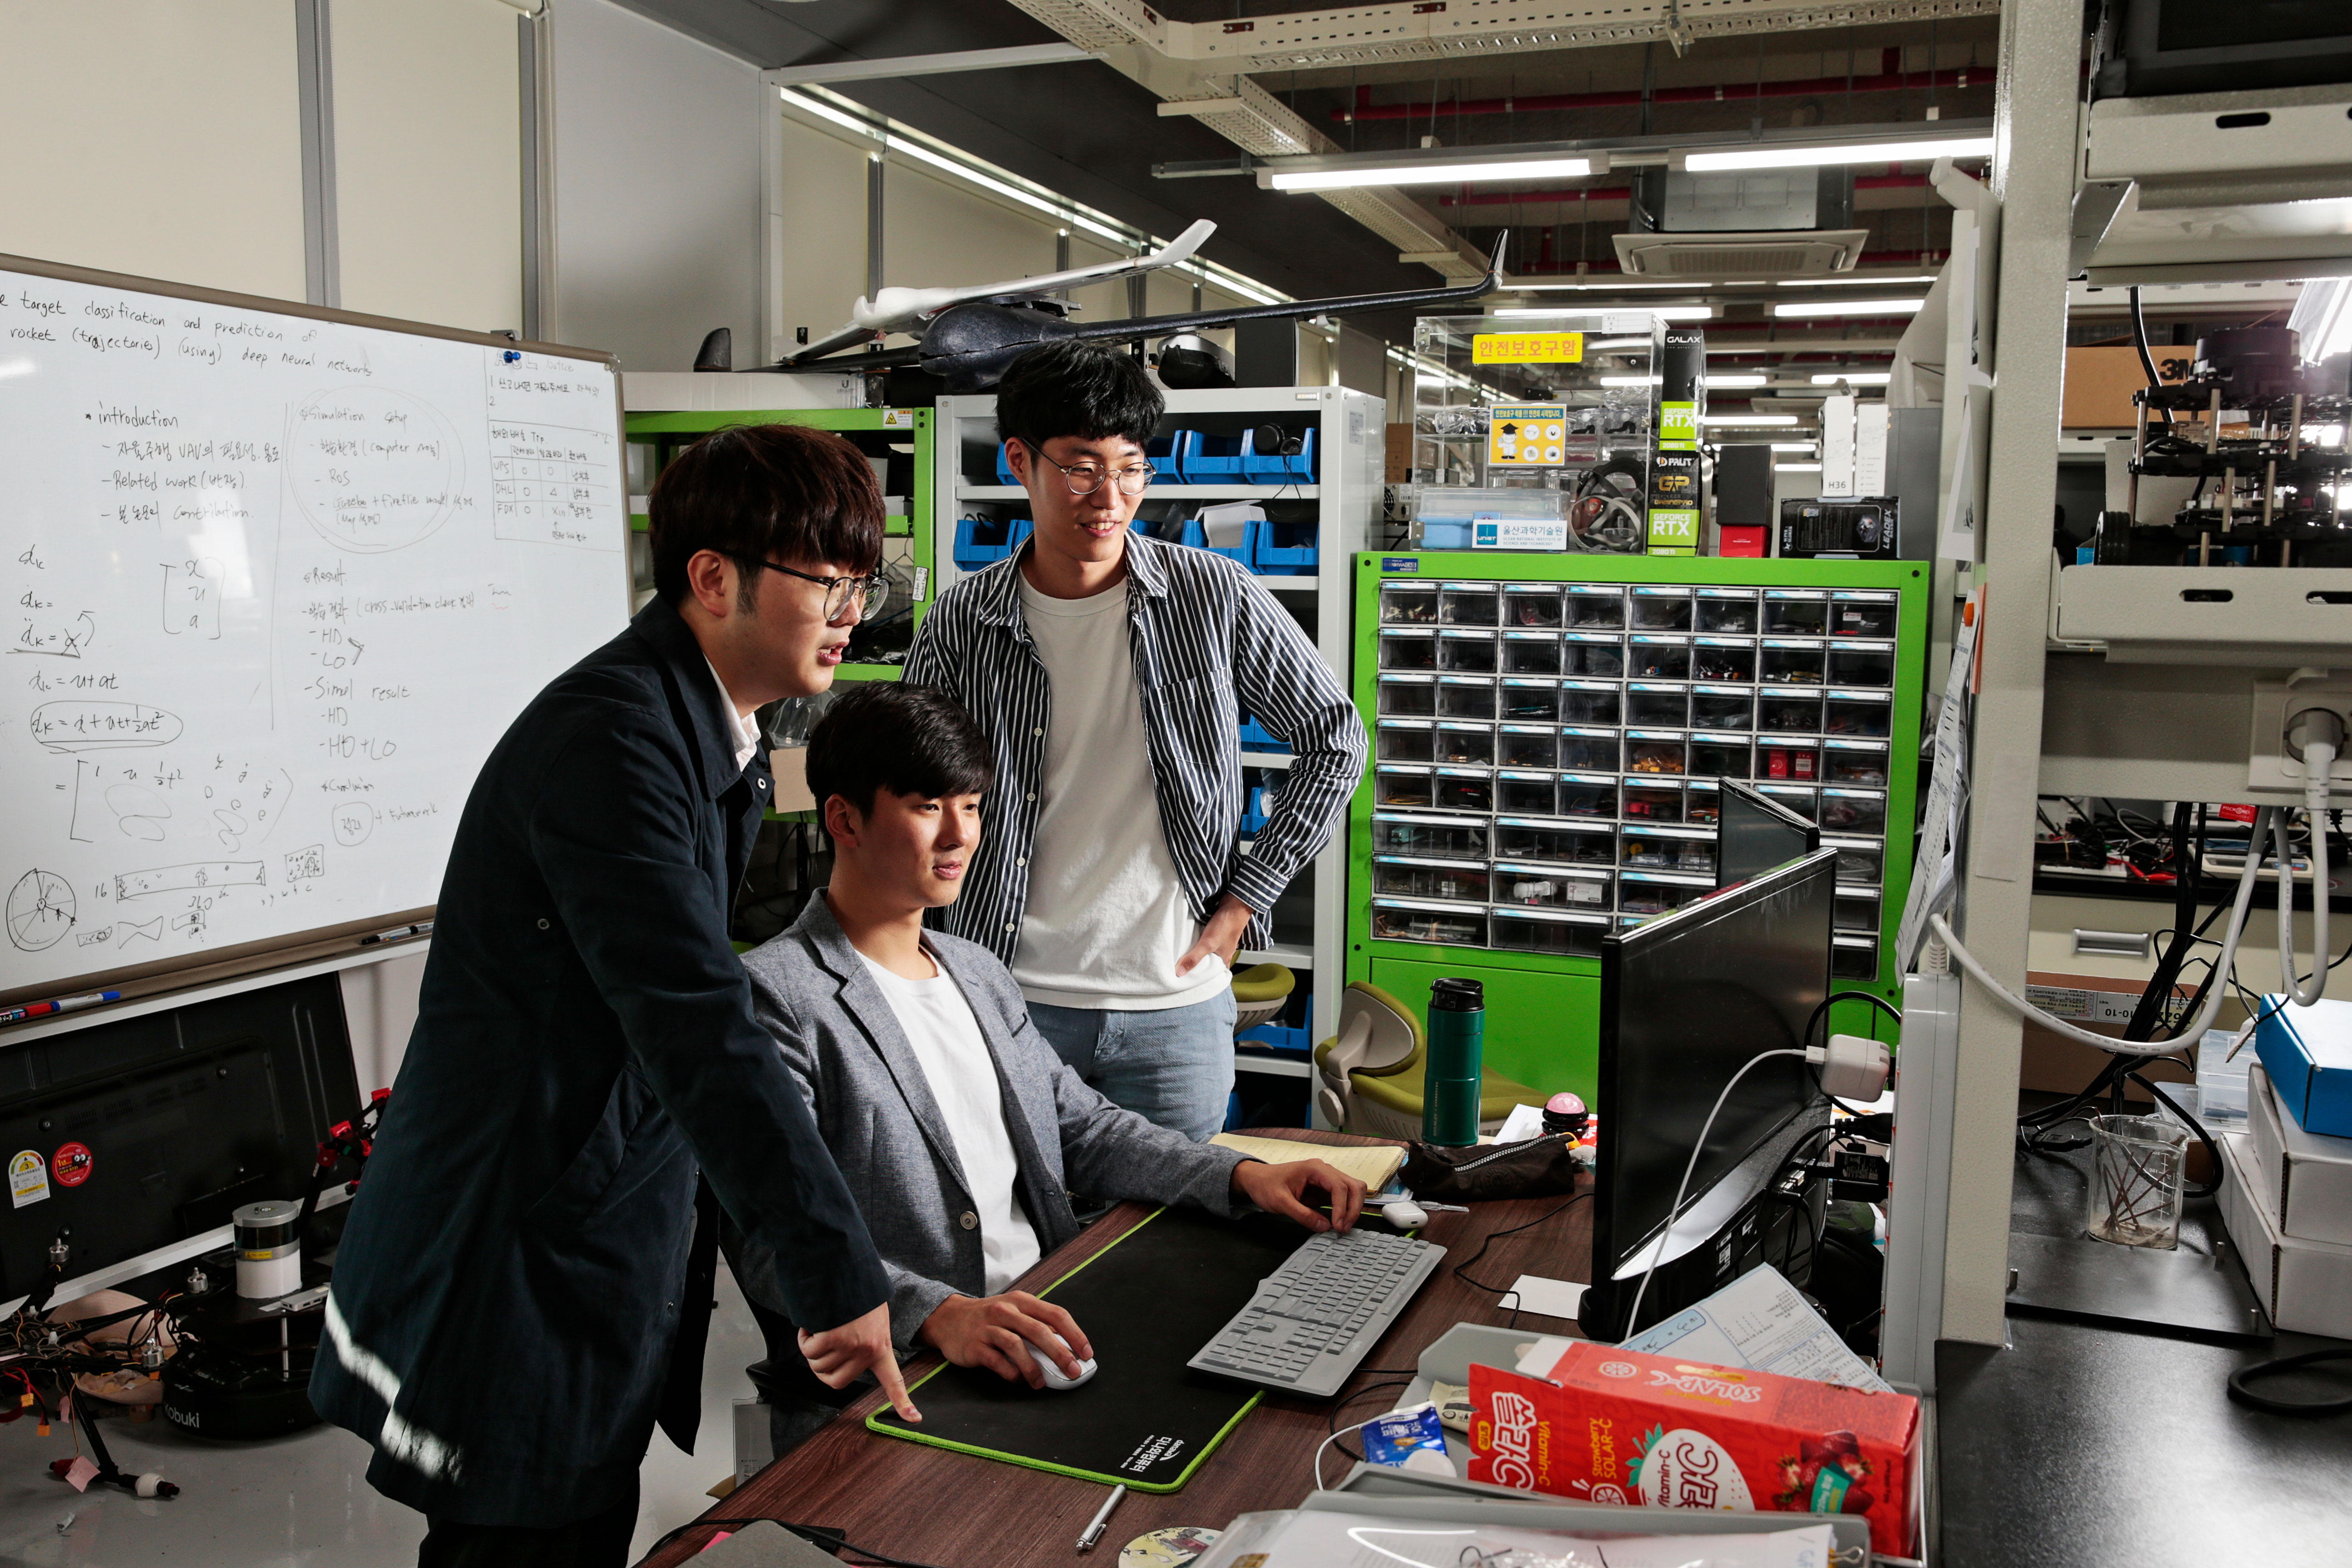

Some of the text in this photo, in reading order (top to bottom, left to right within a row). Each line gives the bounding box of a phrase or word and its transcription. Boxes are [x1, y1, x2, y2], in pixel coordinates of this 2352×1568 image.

[21, 291, 66, 317] target
[85, 301, 165, 327] classification
[184, 317, 200, 329] and
[215, 323, 283, 341] prediction
[303, 329, 317, 343] of
[11, 327, 56, 341] rocket
[178, 337, 221, 364] (using)
[242, 347, 268, 368] deep
[282, 353, 316, 367] neural
[1479, 339, 1577, 358] 안전보호구함
[1666, 335, 1701, 344] GALAX
[99, 401, 178, 428] introduction
[1663, 415, 1695, 427] RTX
[494, 461, 510, 474] UPS
[113, 470, 157, 491] Related
[496, 484, 513, 495] DHL
[1503, 525, 1563, 535] 울산과학기술원
[1653, 521, 1690, 535] RTX
[1883, 509, 1891, 549] LEADEX
[1650, 1369, 1763, 1403] SOLAR-C
[1129, 1437, 1172, 1472] 다나와컴퓨터
[1164, 1440, 1185, 1457] danawa
[1539, 1421, 1551, 1486] Vitamin-C
[1588, 1417, 1603, 1477] Strawberry
[1600, 1418, 1617, 1479] SOLAR-C
